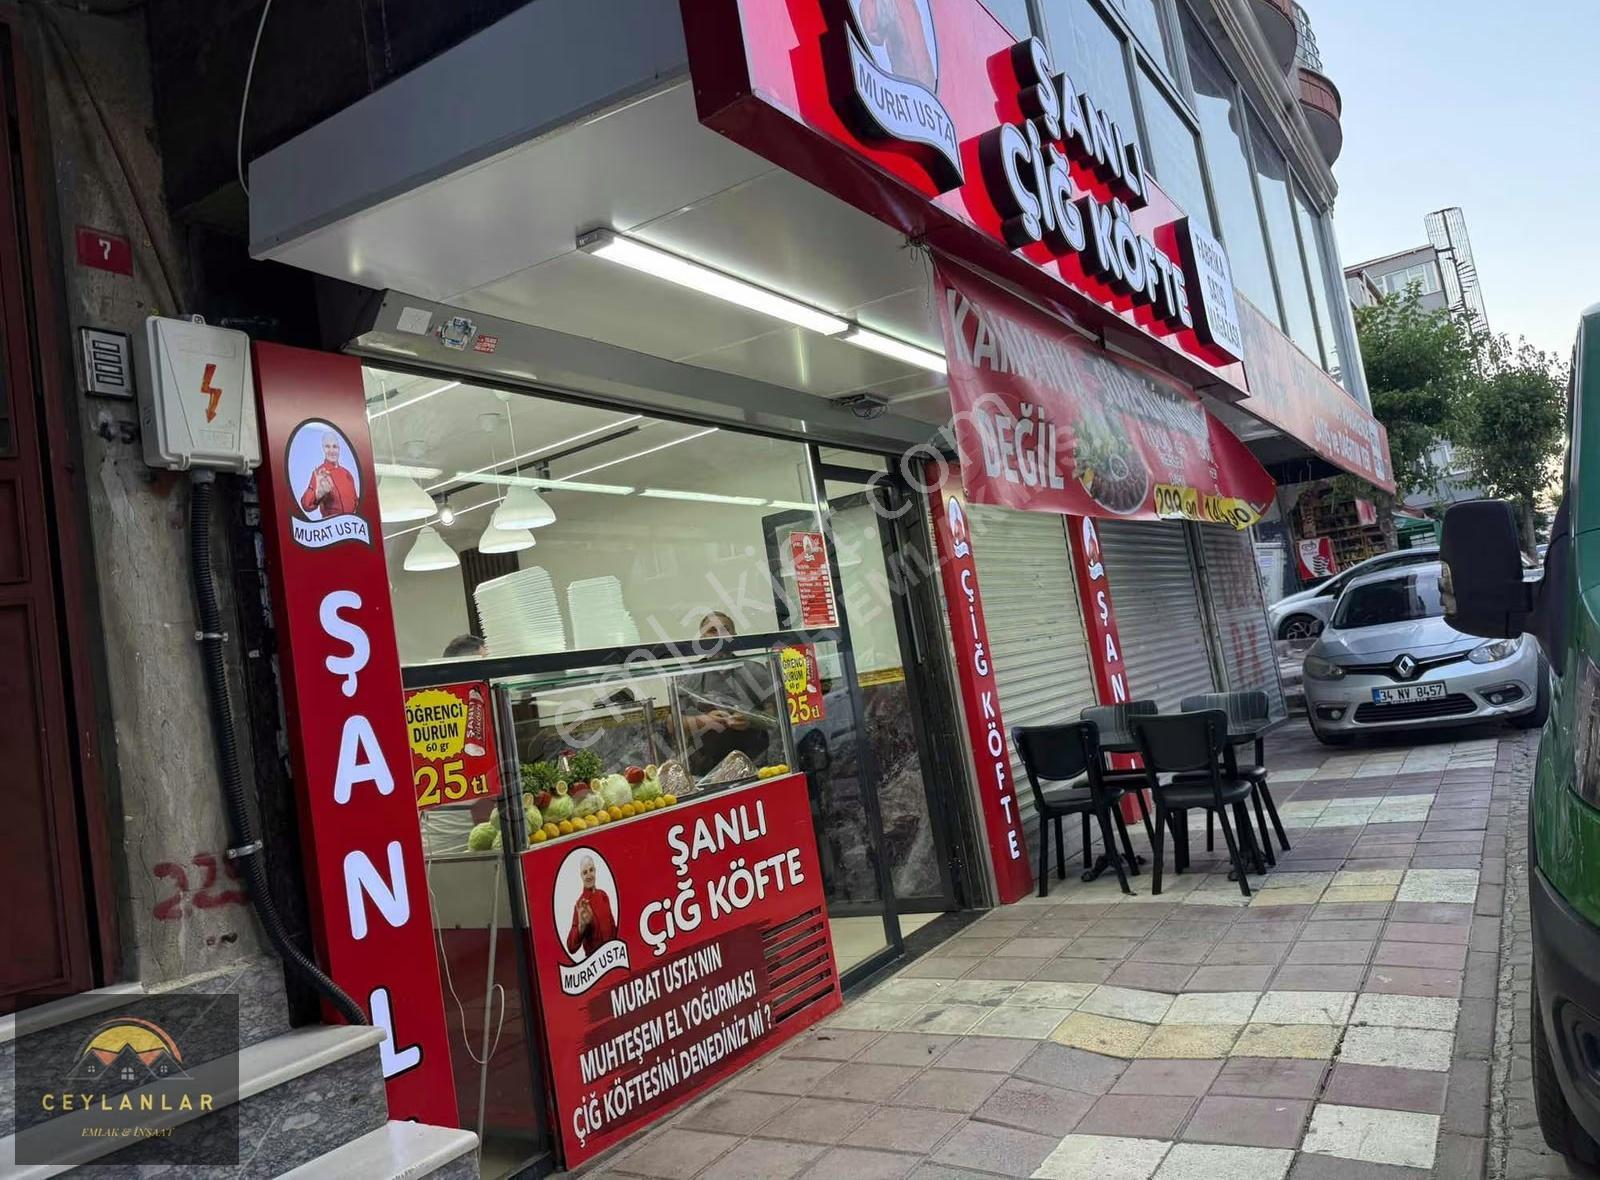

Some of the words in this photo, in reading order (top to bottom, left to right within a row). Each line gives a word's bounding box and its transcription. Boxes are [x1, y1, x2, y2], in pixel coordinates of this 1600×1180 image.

[858, 62, 912, 123] MURAT
[912, 98, 956, 149] USTA
[1029, 36, 1150, 206] ŞANLI
[98, 238, 112, 261] 7
[1086, 194, 1194, 330] KÖFTE
[973, 401, 1065, 490] DEĞİL
[294, 525, 334, 542] MURAT
[335, 521, 367, 536] USTA
[787, 695, 811, 724] 25
[1380, 690, 1393, 701] 34
[1416, 684, 1443, 698] 8457
[413, 720, 459, 743] DÜRÜM
[425, 743, 438, 753] 60
[439, 742, 450, 753] gr
[415, 760, 468, 807] 25
[981, 691, 1020, 861] KÖFTE
[319, 589, 422, 1122] ŞANL
[667, 799, 767, 876] ŞANLI
[706, 847, 806, 922] KÖFTE
[564, 961, 598, 989] MURAT
[598, 946, 627, 969] USTA
[610, 969, 661, 1019] MURAT
[662, 942, 723, 994] USTA'NIN
[579, 1015, 665, 1085] MUHTEŞEM
[664, 1008, 684, 1041] EL
[681, 969, 757, 1030] YOĞURMASI
[573, 1091, 602, 1148] ÇİĞ
[603, 1048, 680, 1123] KÖFTESİNİ
[679, 1014, 749, 1080] DENEDİNİZ
[748, 1001, 765, 1041] Mİ
